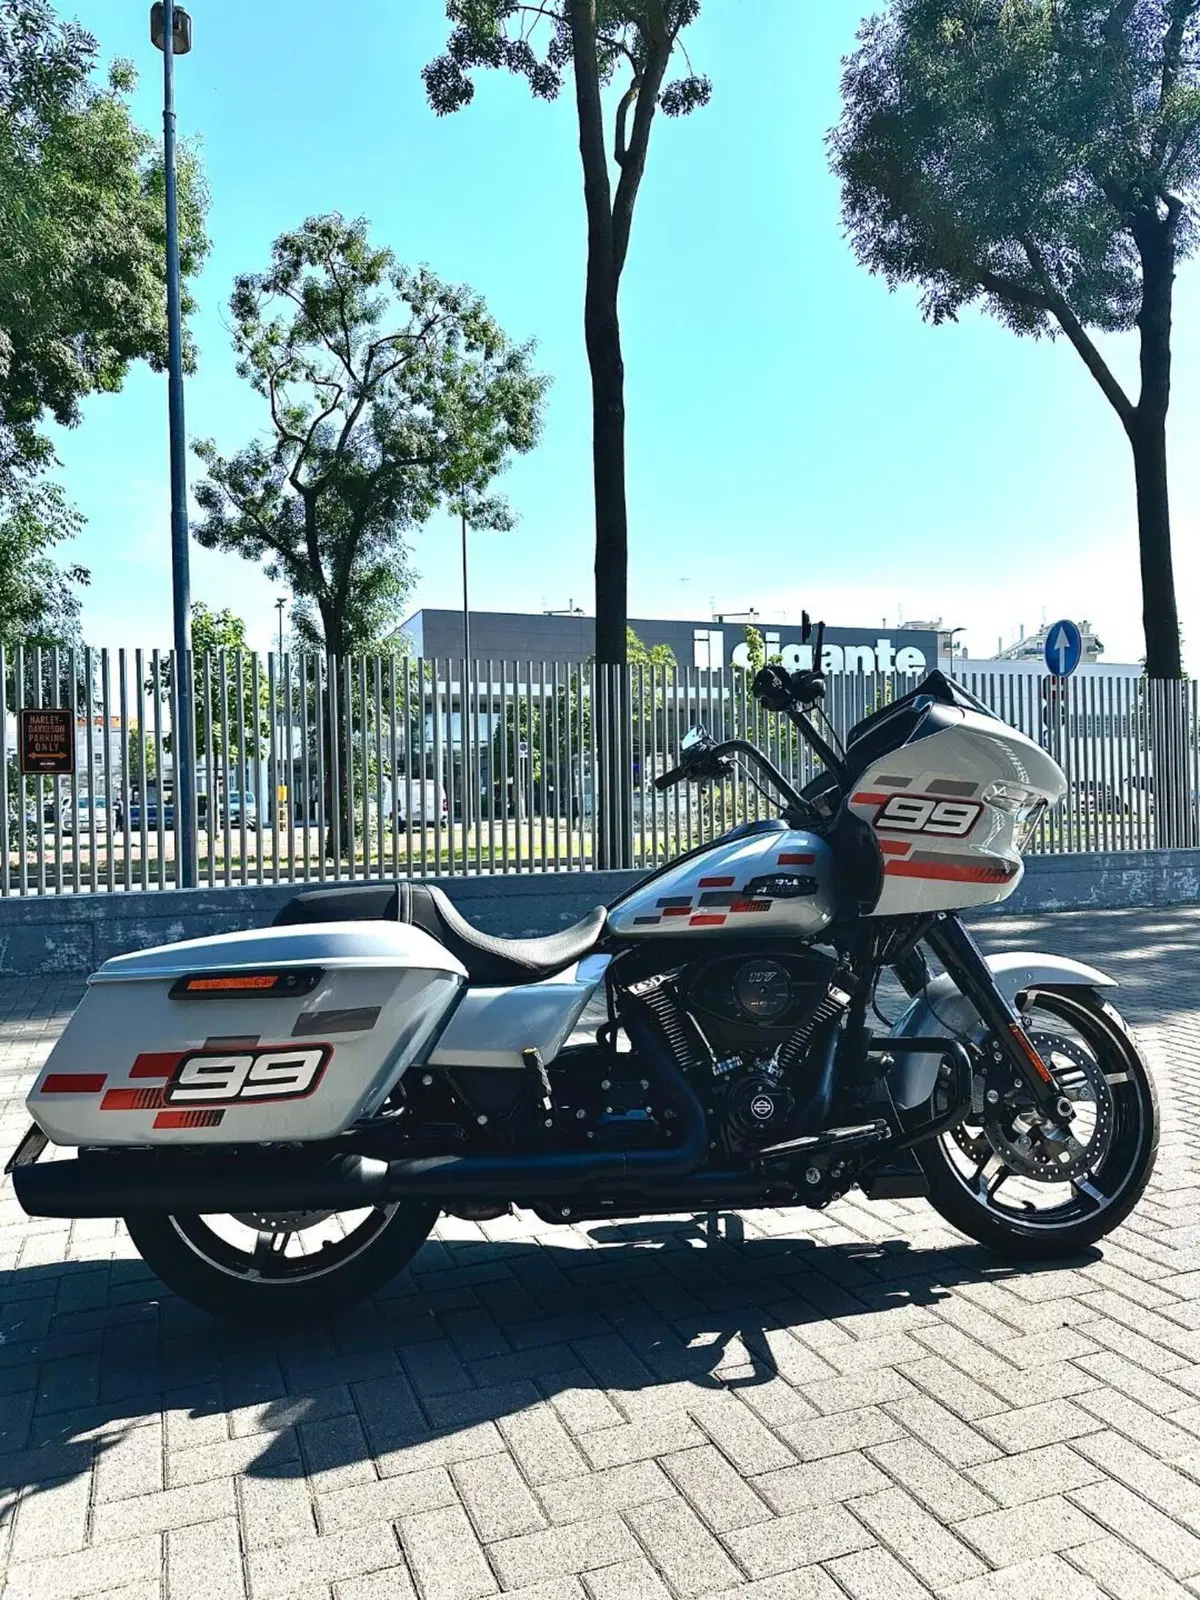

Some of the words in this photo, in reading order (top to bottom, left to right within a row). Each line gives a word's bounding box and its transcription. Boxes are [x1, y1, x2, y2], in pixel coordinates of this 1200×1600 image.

[694, 629, 724, 672] il
[28, 725, 65, 733] DAVIDSON
[29, 734, 65, 742] PARKING
[35, 743, 59, 752] ONLY
[876, 797, 980, 835] 99
[170, 1050, 323, 1100] 99
